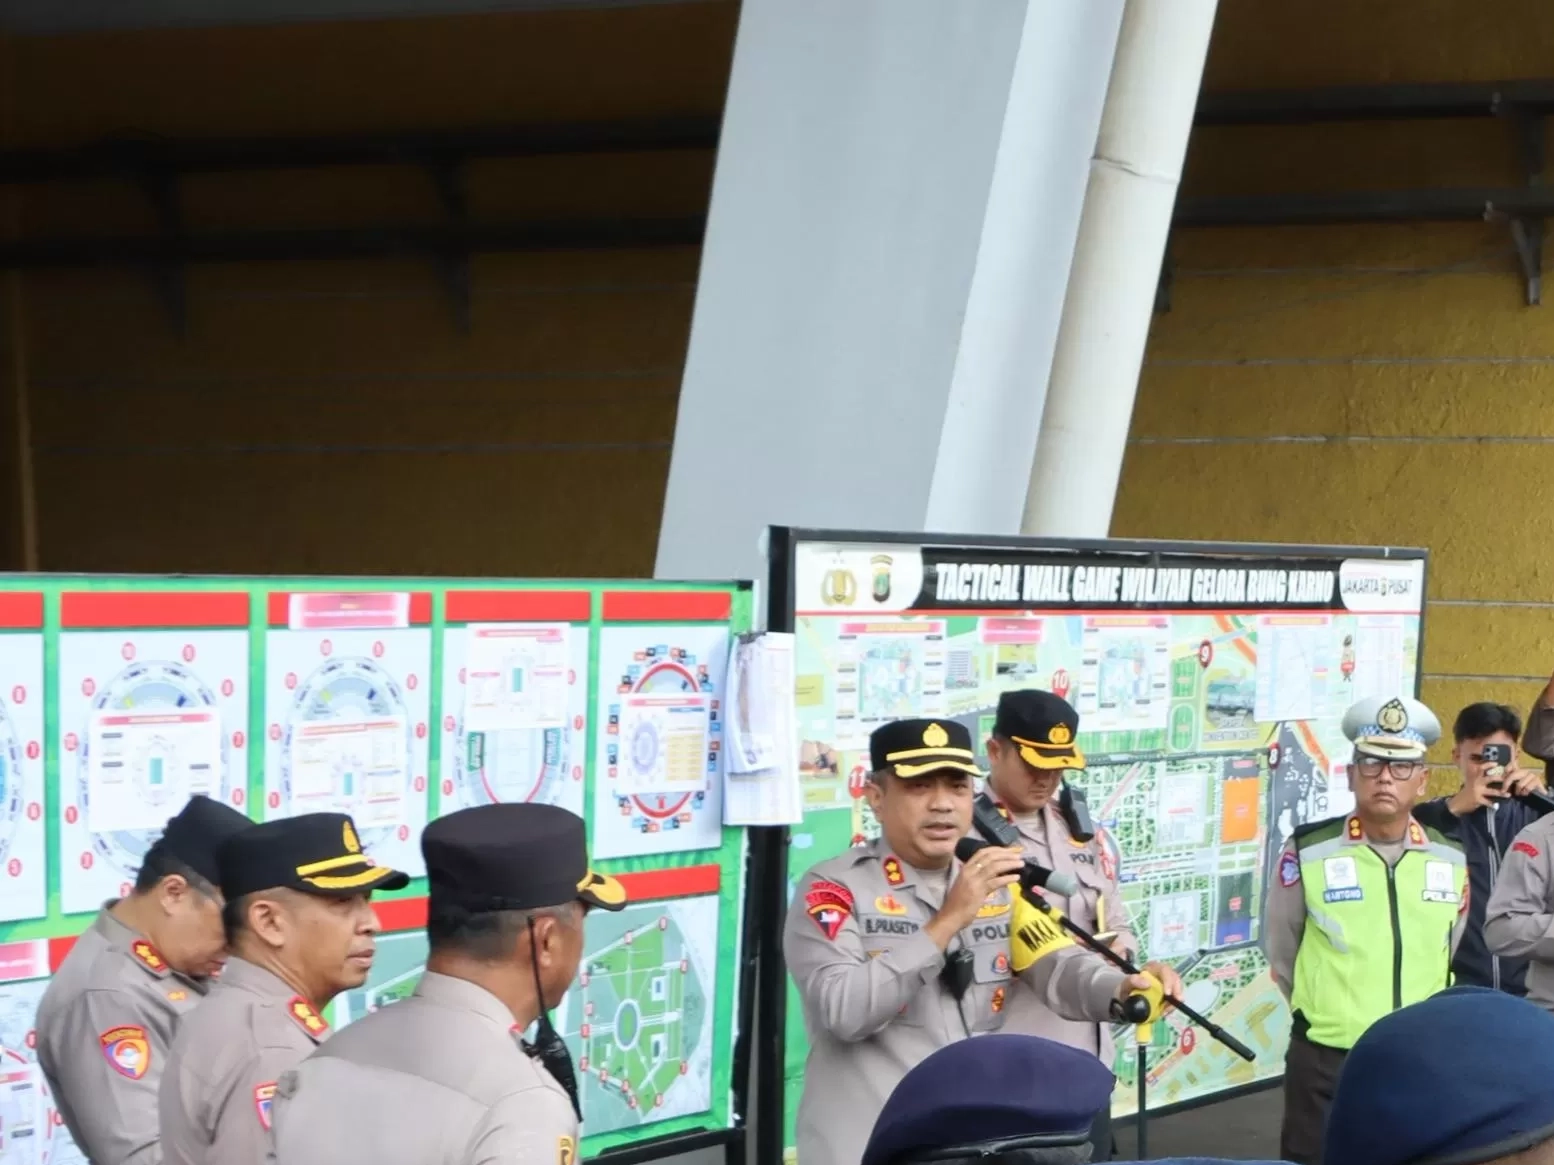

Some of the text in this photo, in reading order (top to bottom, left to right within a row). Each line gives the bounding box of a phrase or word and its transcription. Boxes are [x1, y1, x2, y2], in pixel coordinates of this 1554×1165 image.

[936, 563, 1020, 600] TACTICAL
[1023, 565, 1070, 601] WALL
[1073, 566, 1121, 601] GAME
[1192, 568, 1246, 602] GELORA
[1247, 569, 1287, 602] BUNG
[1288, 570, 1335, 602] KARNO
[1342, 579, 1412, 595] JAKARTA PUSAT
[1201, 646, 1210, 662] 9
[1053, 673, 1068, 688] 10
[851, 772, 865, 788] 11
[971, 923, 1010, 943] POL
